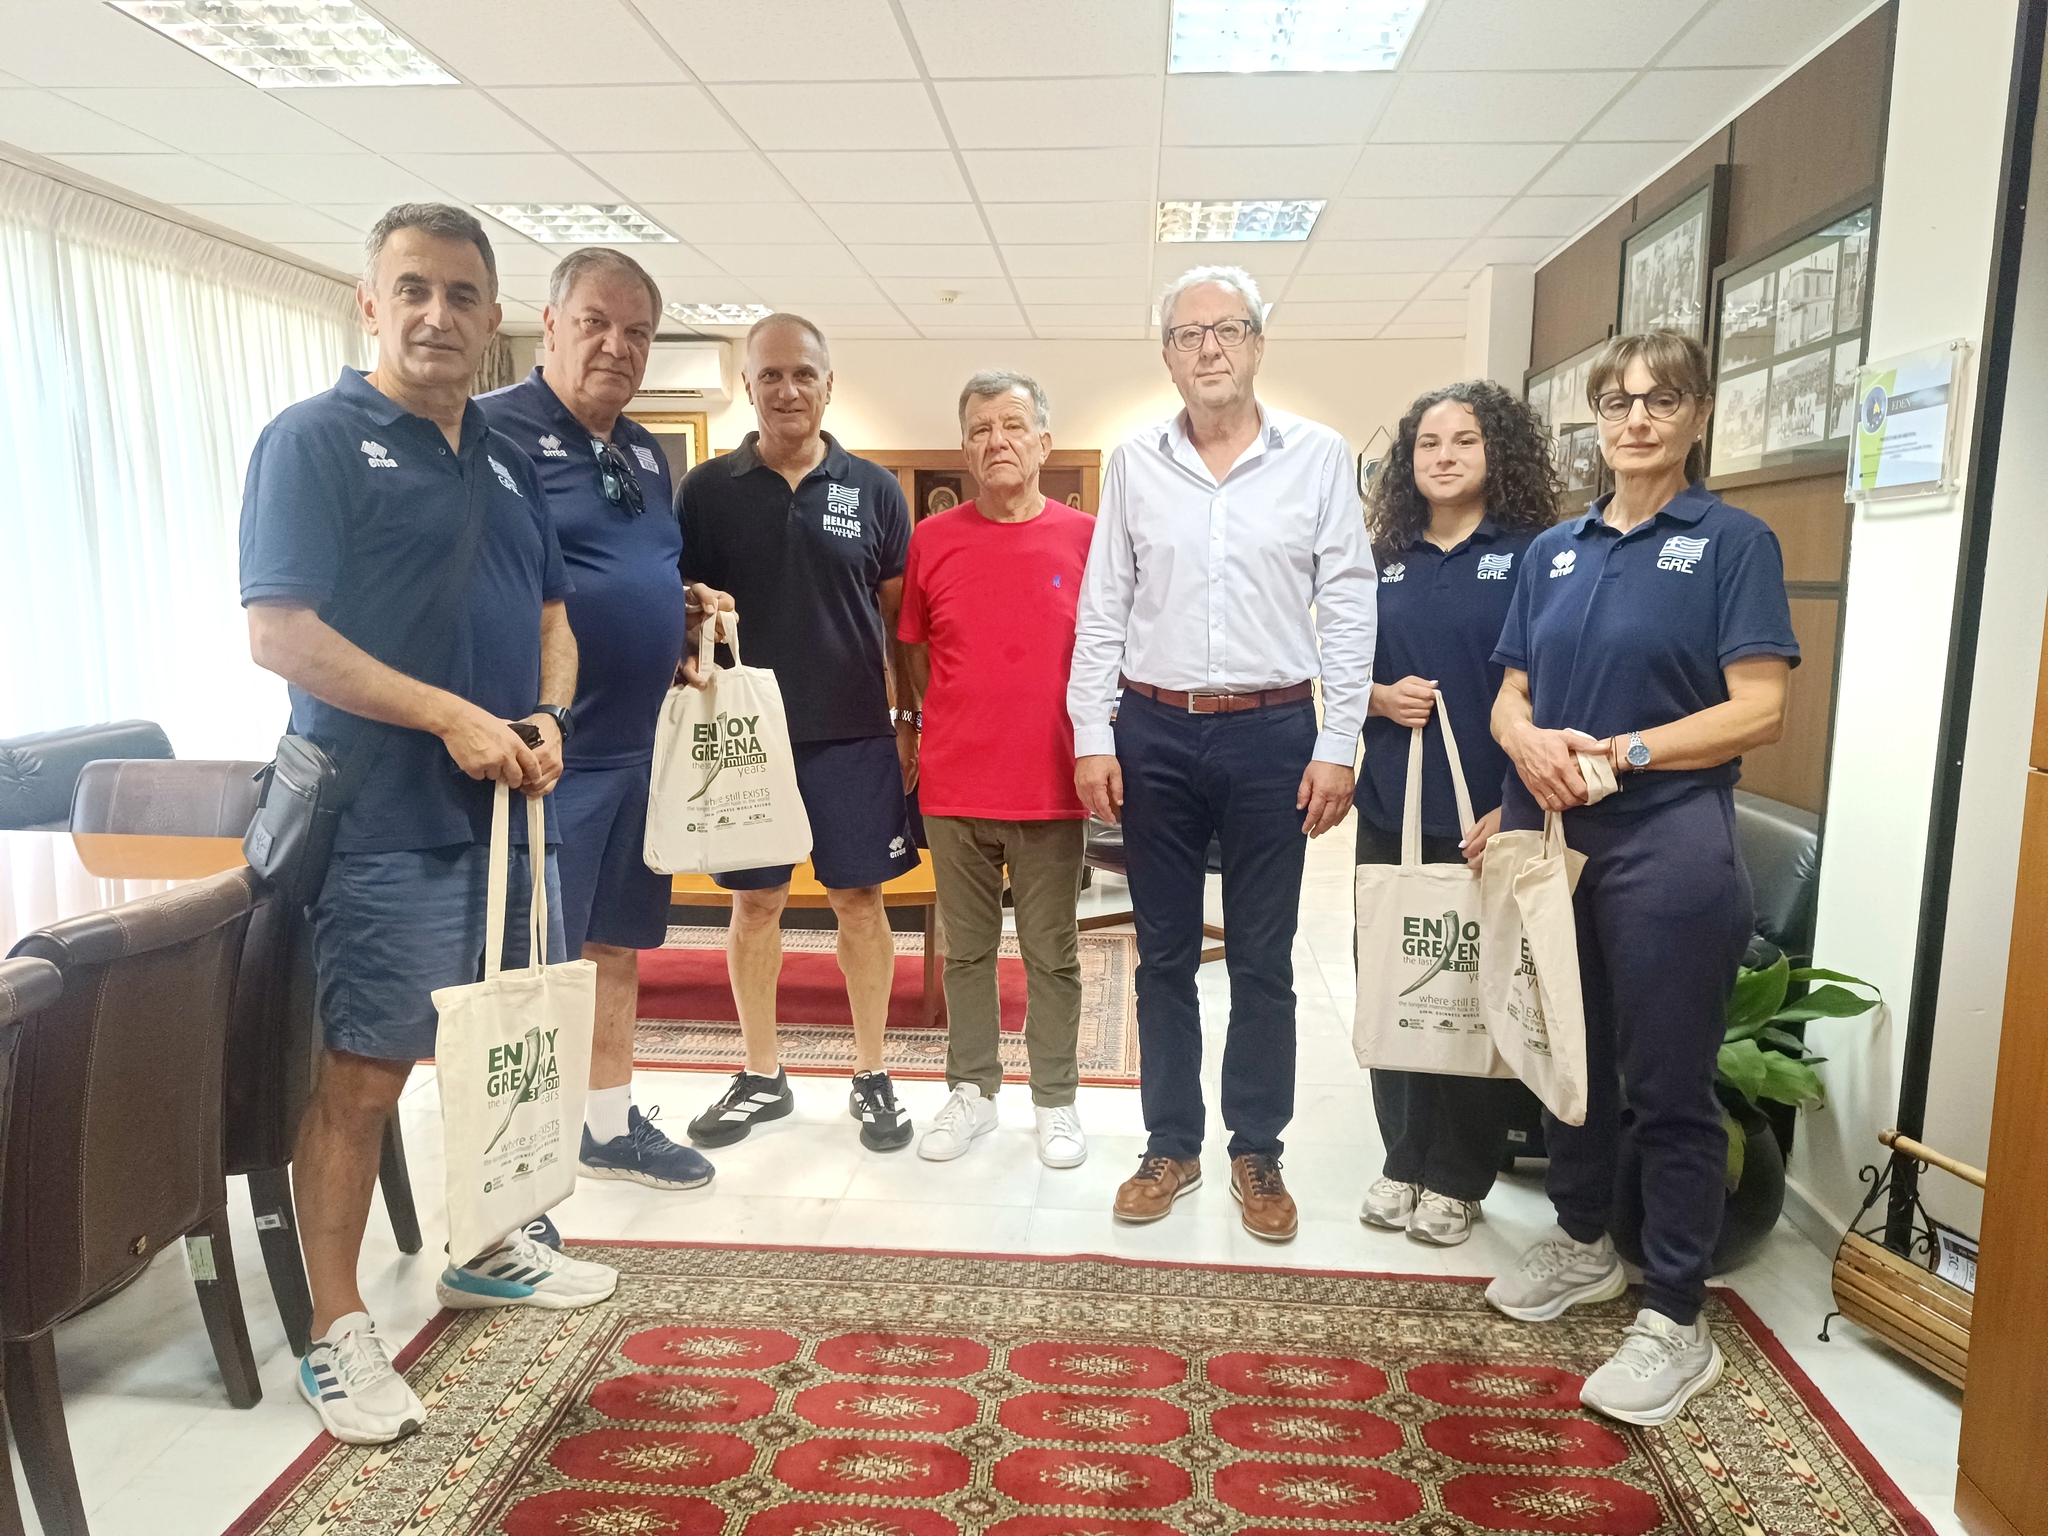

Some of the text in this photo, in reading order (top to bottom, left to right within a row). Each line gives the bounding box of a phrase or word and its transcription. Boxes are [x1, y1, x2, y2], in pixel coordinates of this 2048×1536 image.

[1891, 398, 1911, 411] EDEN
[828, 502, 858, 518] GRE
[823, 514, 862, 533] HELLAS
[1656, 557, 1697, 574] GRE
[1477, 569, 1508, 580] GRE
[727, 754, 765, 768] million
[737, 764, 766, 778] years
[725, 791, 741, 802] still
[742, 787, 770, 800] EXISTS
[1403, 914, 1480, 941] ENJO
[1402, 938, 1480, 960] GREVEN
[1403, 956, 1432, 965] the last
[1448, 960, 1455, 971] 3
[1418, 994, 1449, 1006] where
[1451, 997, 1468, 1007] still
[528, 1089, 535, 1101] 3
[488, 1099, 500, 1109] the
